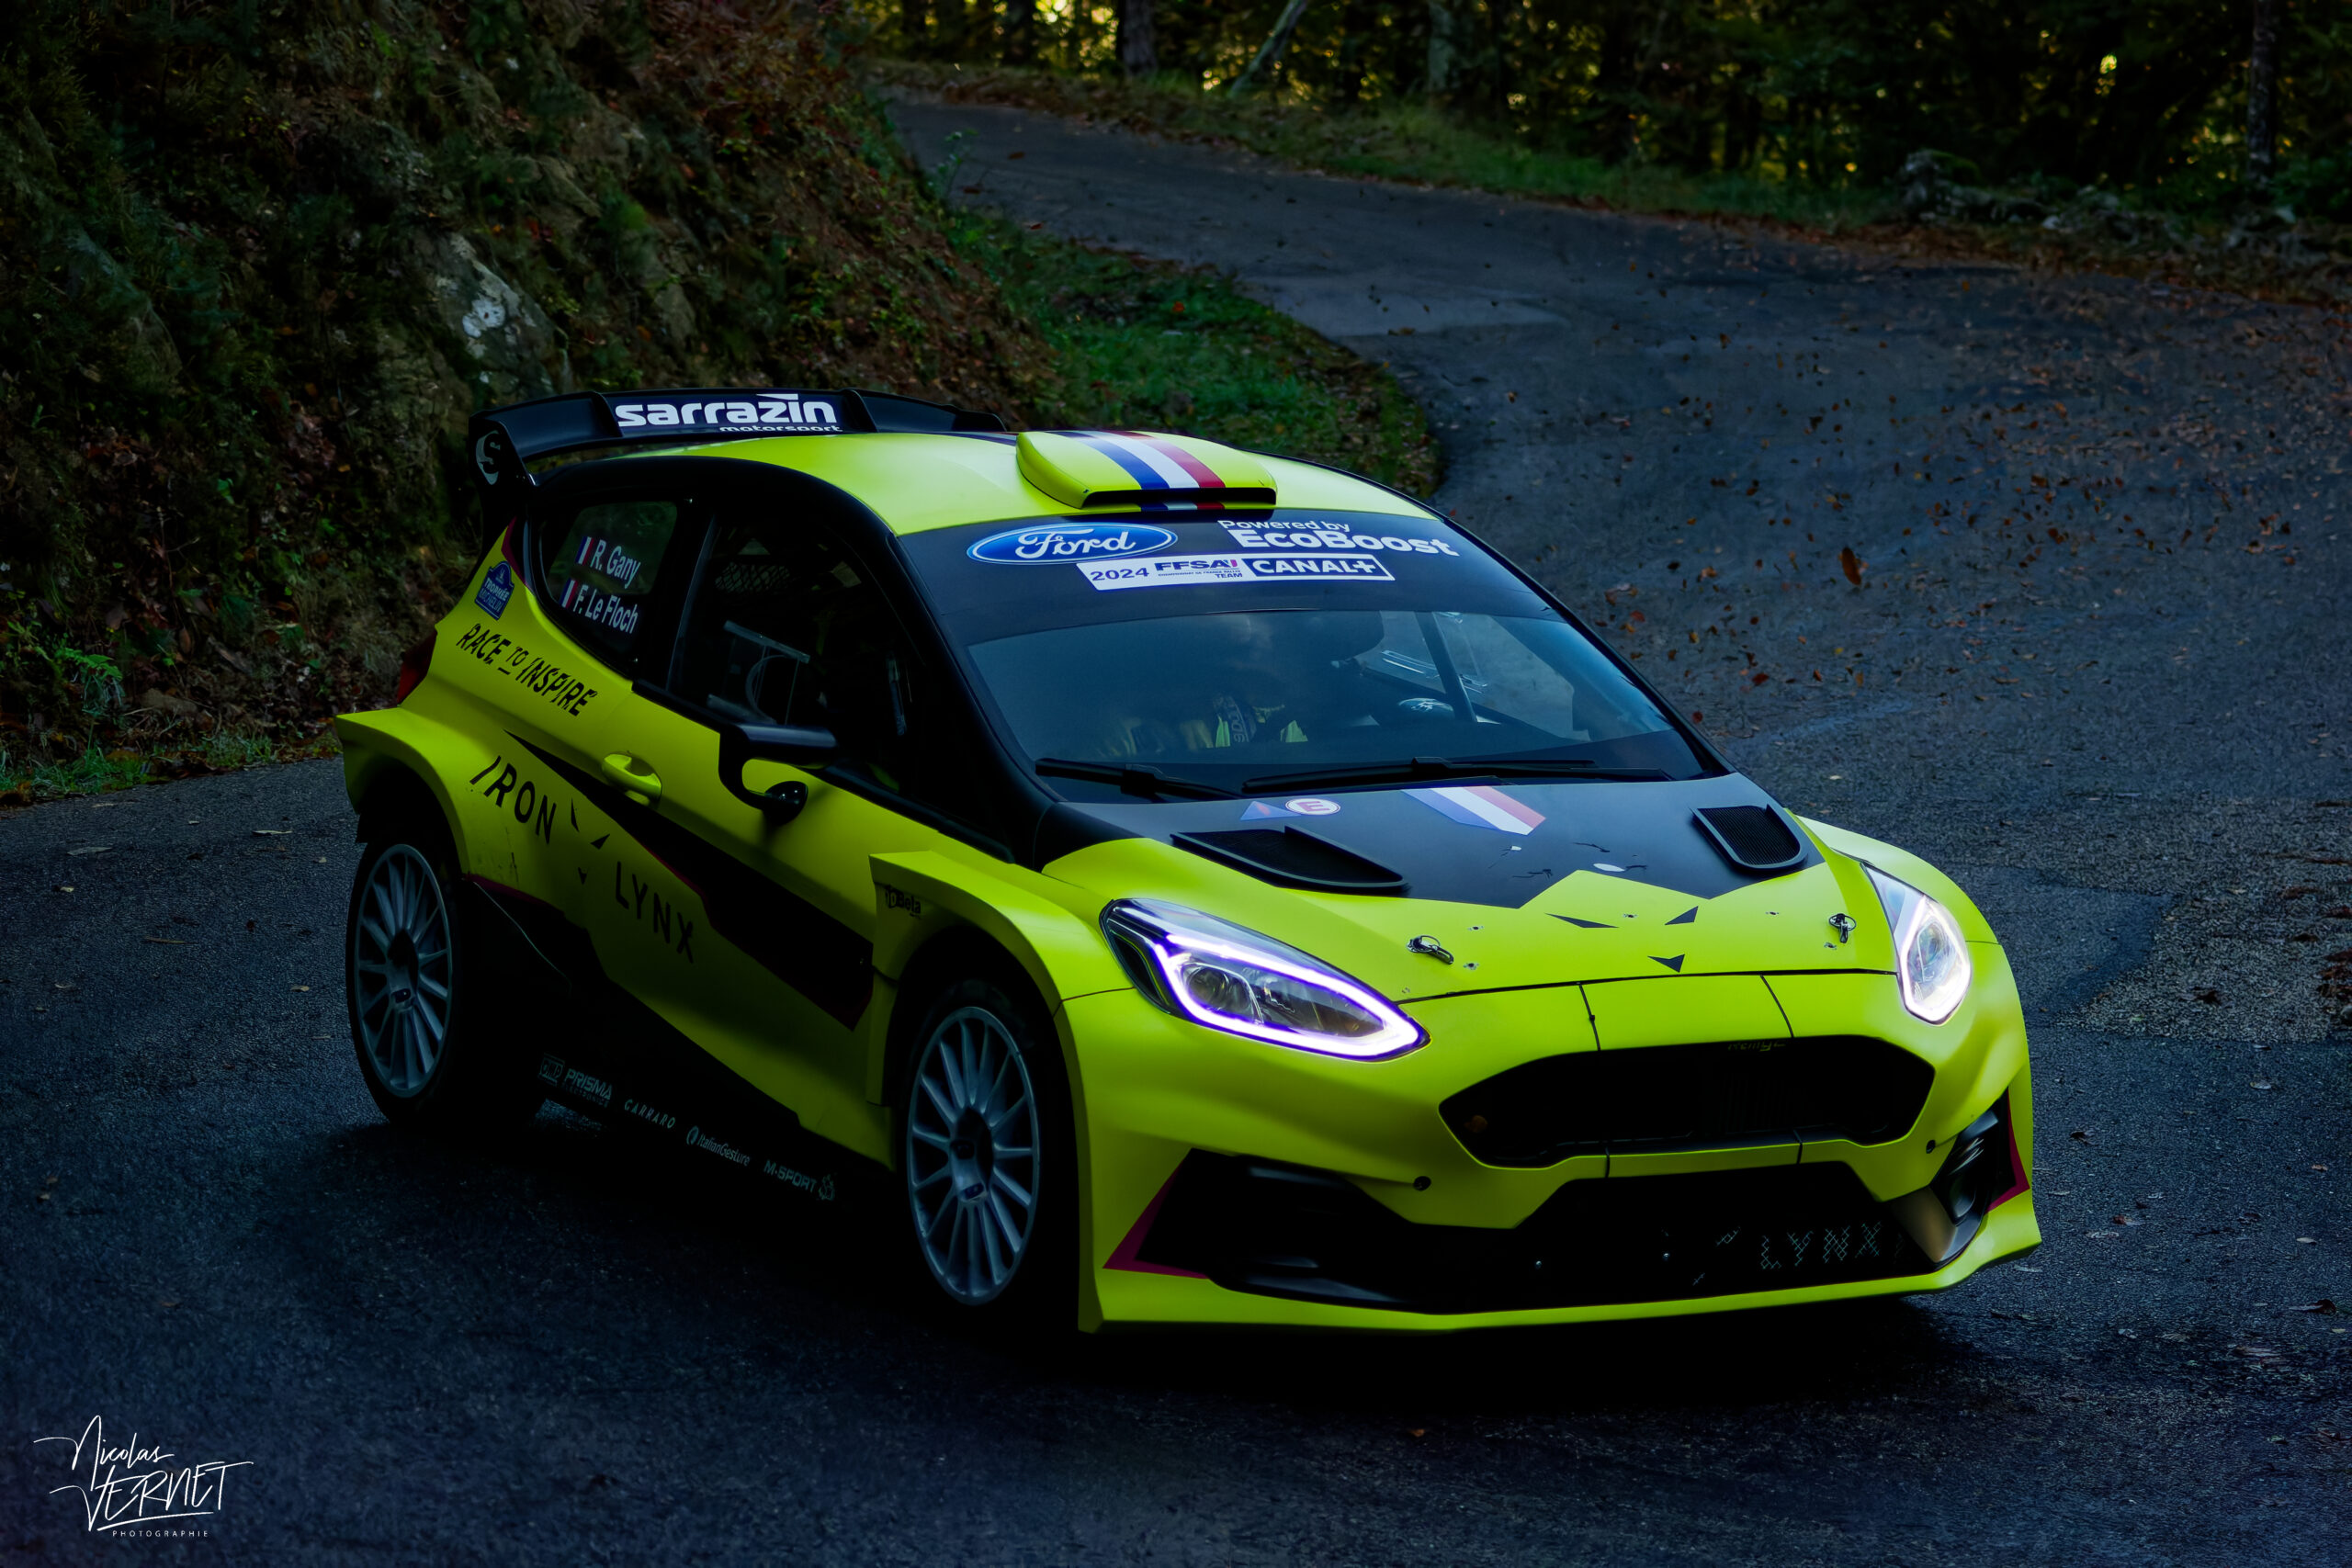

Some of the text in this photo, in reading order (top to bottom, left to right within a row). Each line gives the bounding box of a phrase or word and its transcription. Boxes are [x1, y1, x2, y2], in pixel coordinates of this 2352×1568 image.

[615, 393, 838, 427] sarrazin
[1014, 526, 1136, 558] Ford
[1217, 520, 1351, 533] Powered by
[1230, 529, 1460, 557] EcoBoost
[590, 539, 641, 589] R. Gany
[1090, 568, 1149, 581] 2024
[1252, 559, 1376, 573] CANAL+
[572, 584, 639, 634] F. Le Floch
[456, 623, 598, 717] RACE TO INSPIRE
[469, 755, 557, 844] IRON
[616, 861, 695, 964] LYNX
[564, 1067, 614, 1100] PRISMA
[1758, 1221, 1882, 1269] LYNX
